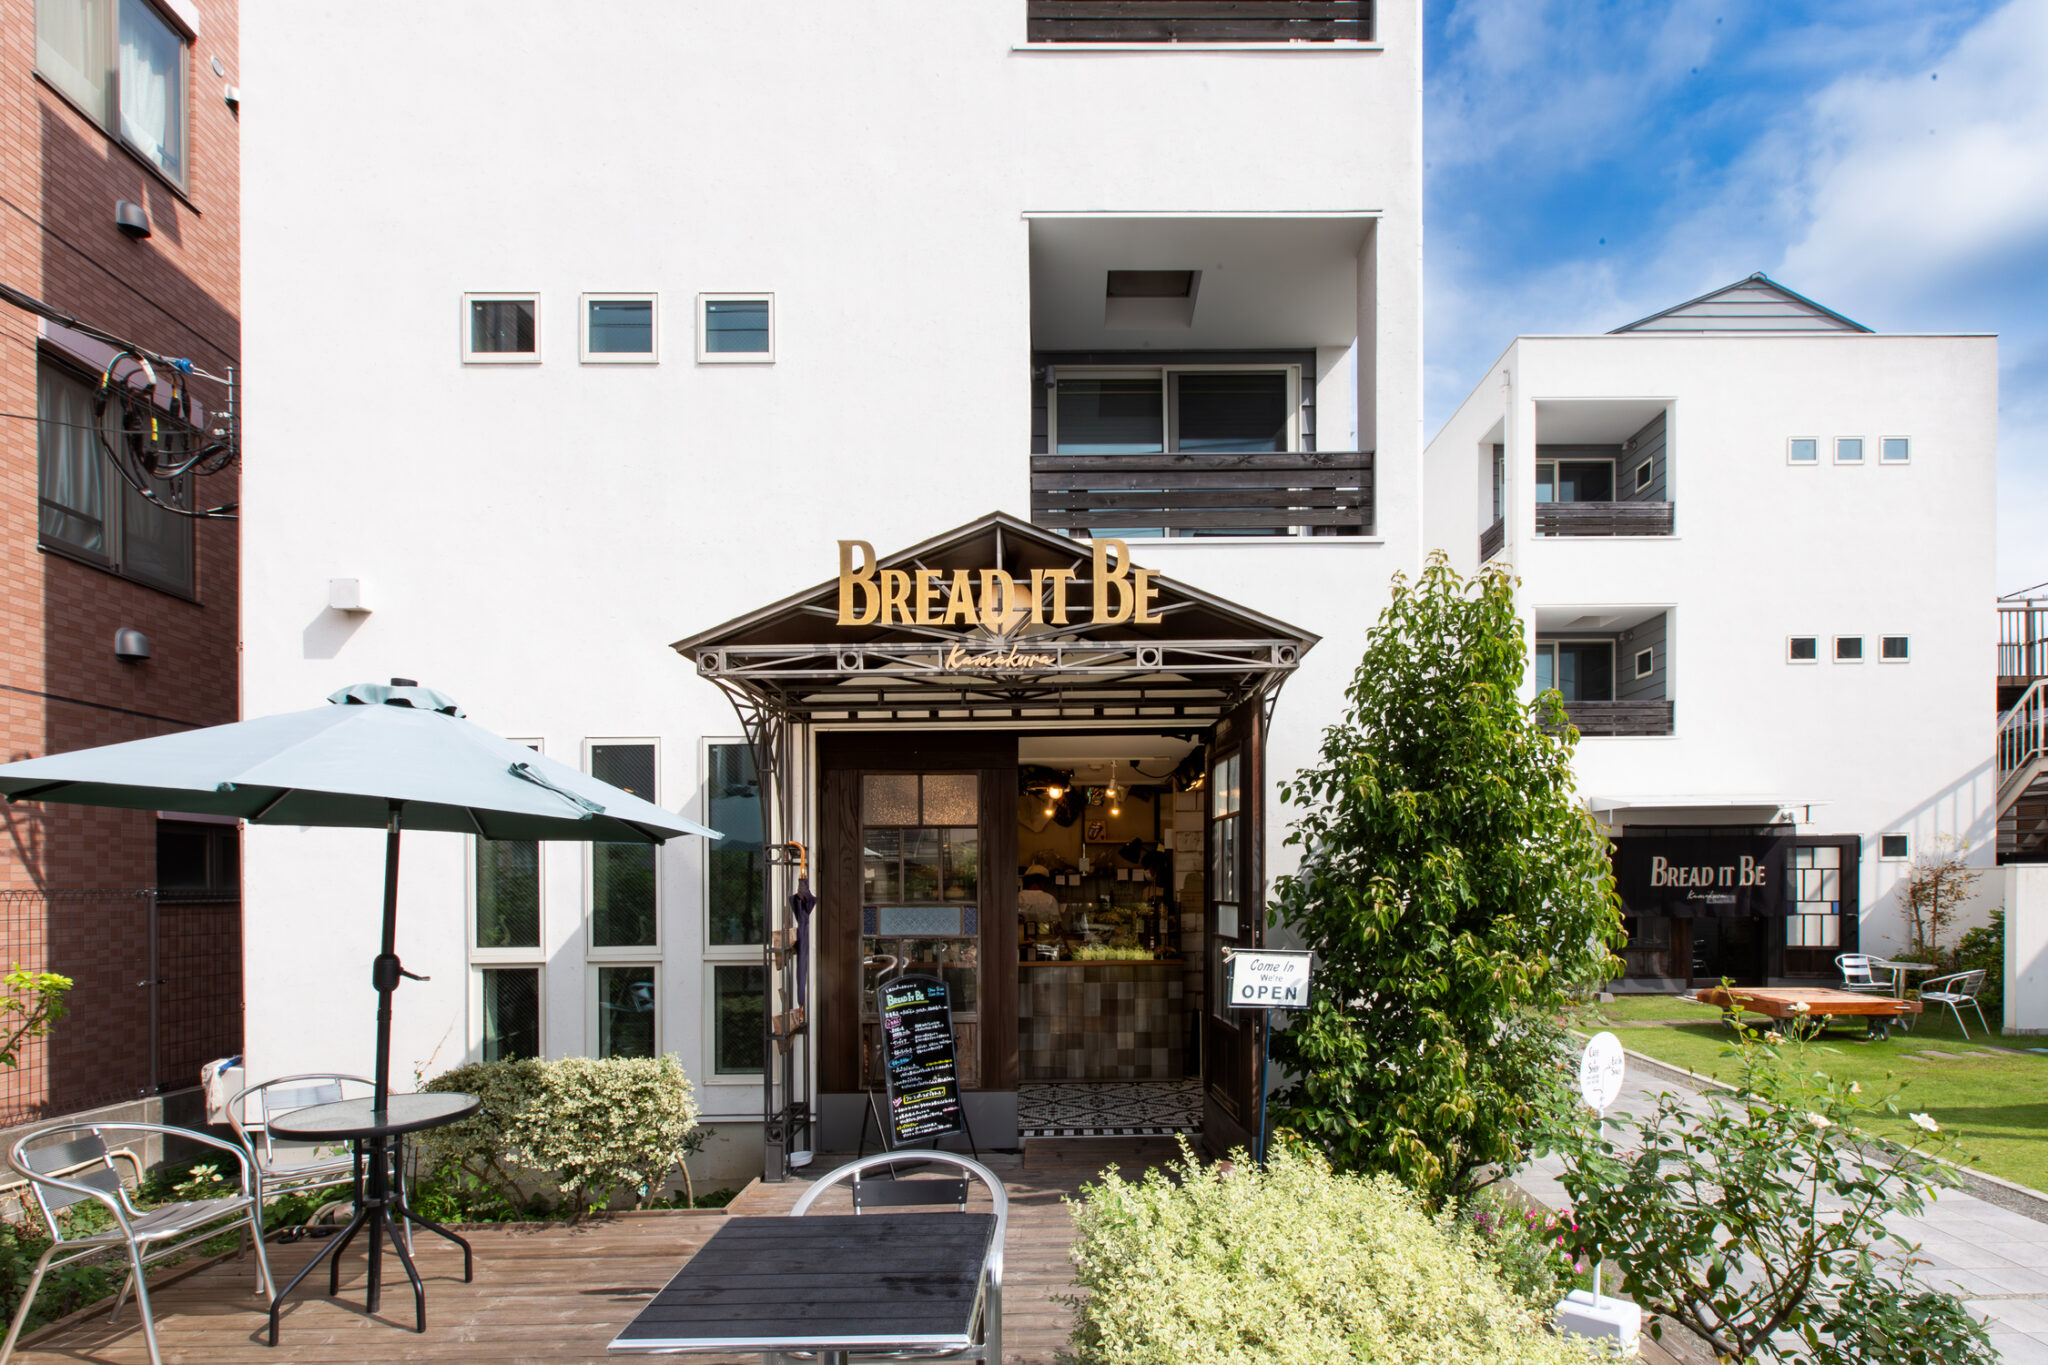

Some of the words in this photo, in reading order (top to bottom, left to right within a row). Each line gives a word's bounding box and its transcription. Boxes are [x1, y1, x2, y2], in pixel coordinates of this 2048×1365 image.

[836, 539, 1015, 626] BREAD
[1030, 568, 1077, 625] IT
[1091, 538, 1164, 625] BE
[944, 642, 1057, 671] Kamakura
[1650, 856, 1715, 887] BREAD
[1718, 866, 1736, 887] IT
[1738, 855, 1767, 887] BE
[1250, 958, 1280, 972] Come
[1283, 961, 1295, 973] In
[1242, 984, 1298, 1001] OPEN
